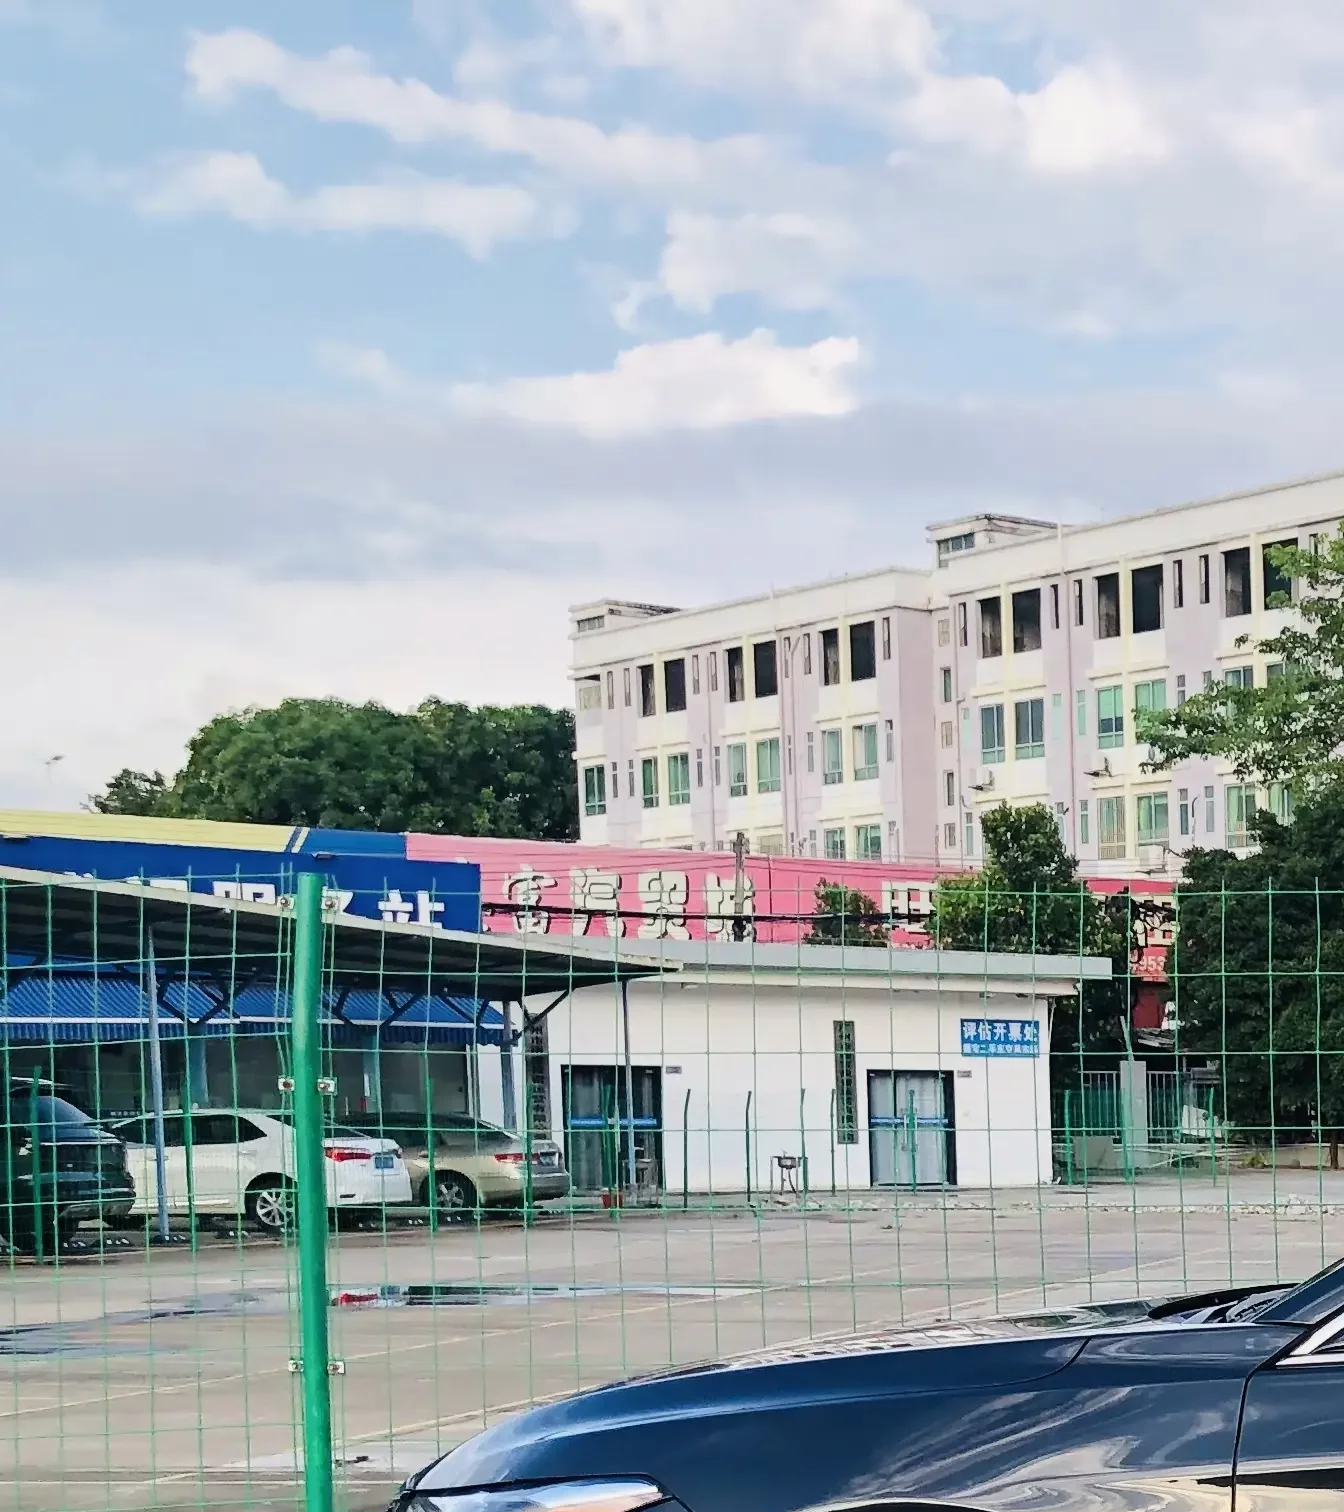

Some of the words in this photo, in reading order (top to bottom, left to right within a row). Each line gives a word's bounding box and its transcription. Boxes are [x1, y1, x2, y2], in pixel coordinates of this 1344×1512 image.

[963, 1021, 1037, 1042] 评估开票处
